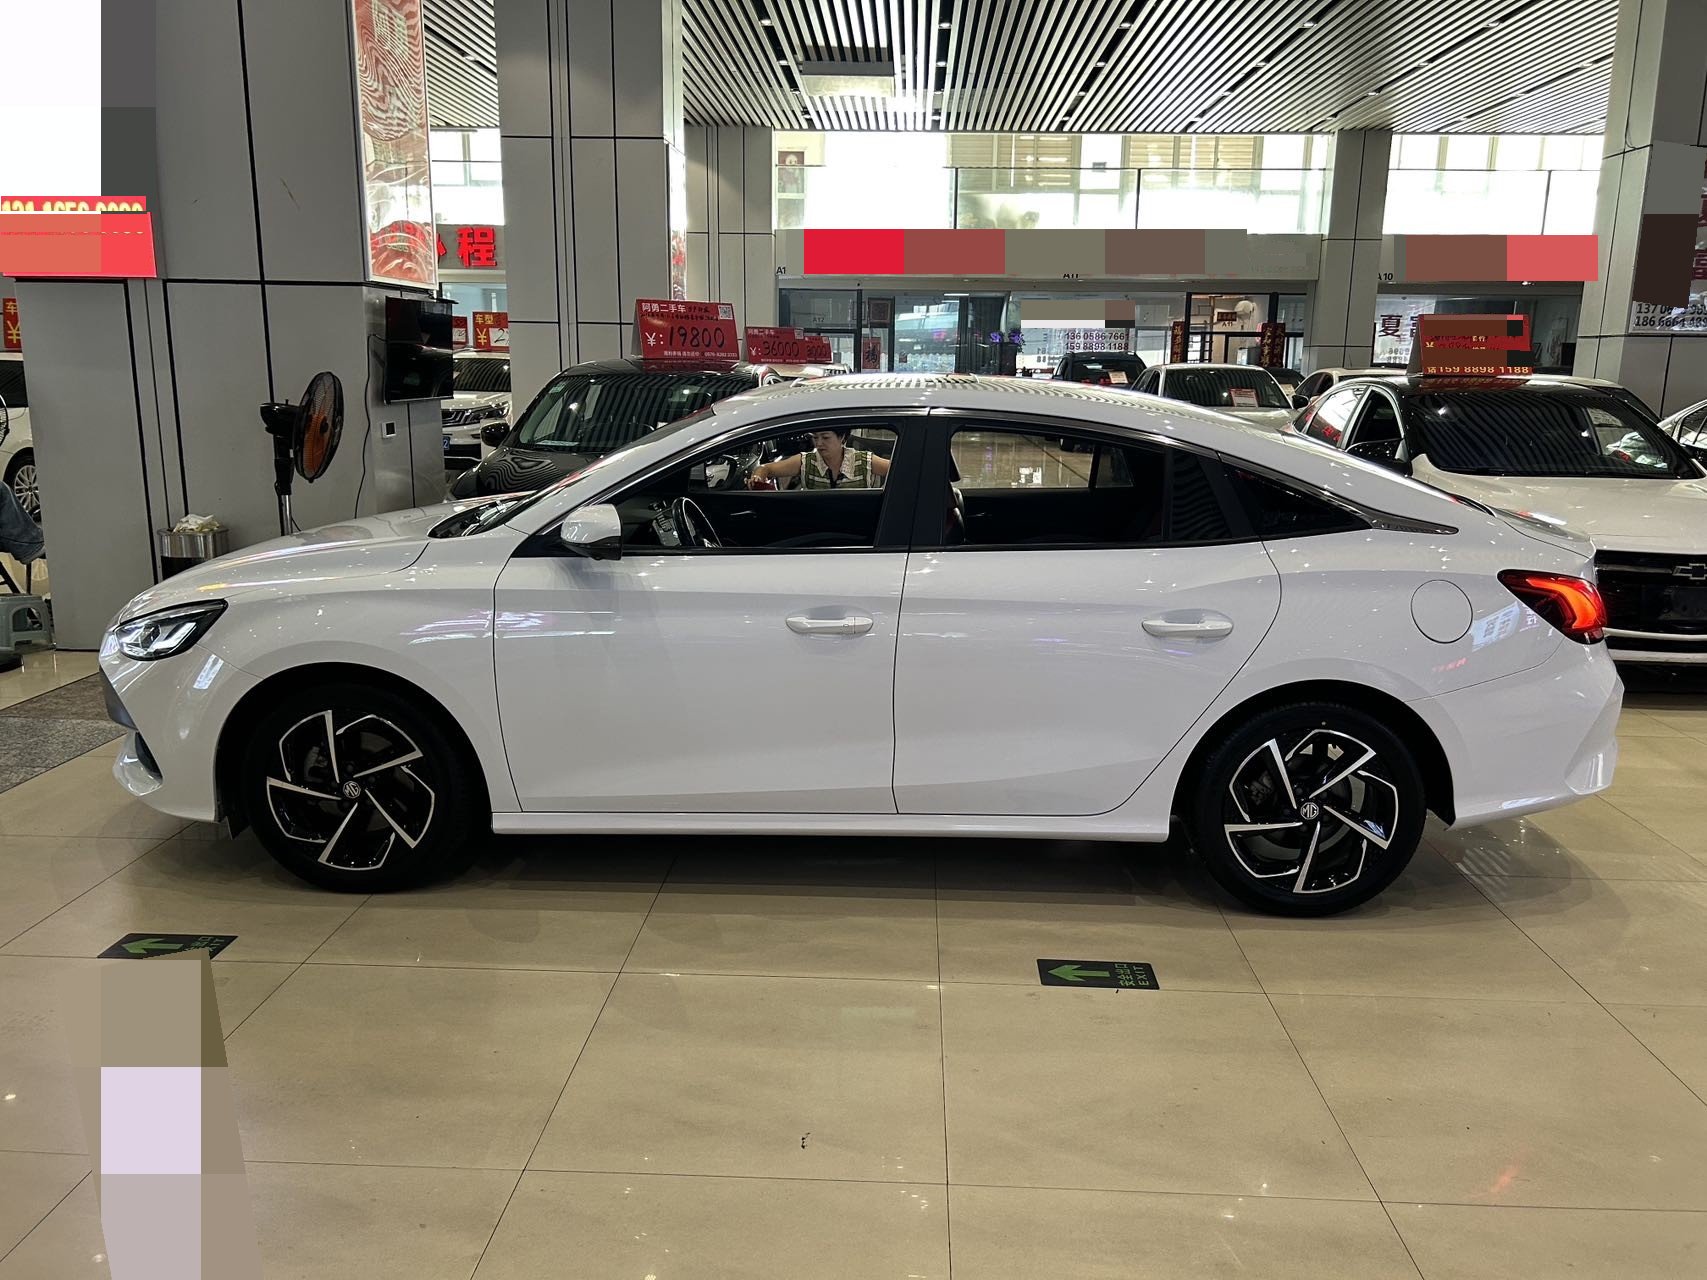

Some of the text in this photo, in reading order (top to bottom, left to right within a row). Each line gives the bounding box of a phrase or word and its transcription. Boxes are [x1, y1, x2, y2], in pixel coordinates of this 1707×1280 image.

[437, 228, 497, 268] 程
[641, 302, 687, 313] 阿勇二手车
[1637, 303, 1658, 314] 137
[475, 314, 495, 326] 车型
[1635, 316, 1656, 327] 186
[494, 327, 509, 344] 2
[669, 326, 725, 349] 19800
[1065, 332, 1081, 340] 136
[1083, 332, 1106, 340] 0586
[763, 341, 799, 357] 36000
[1065, 342, 1129, 350] 159 8898 1188
[1302, 803, 1318, 819] MG
[1115, 963, 1136, 987] 安全出口
[1133, 965, 1149, 986] EXIT
